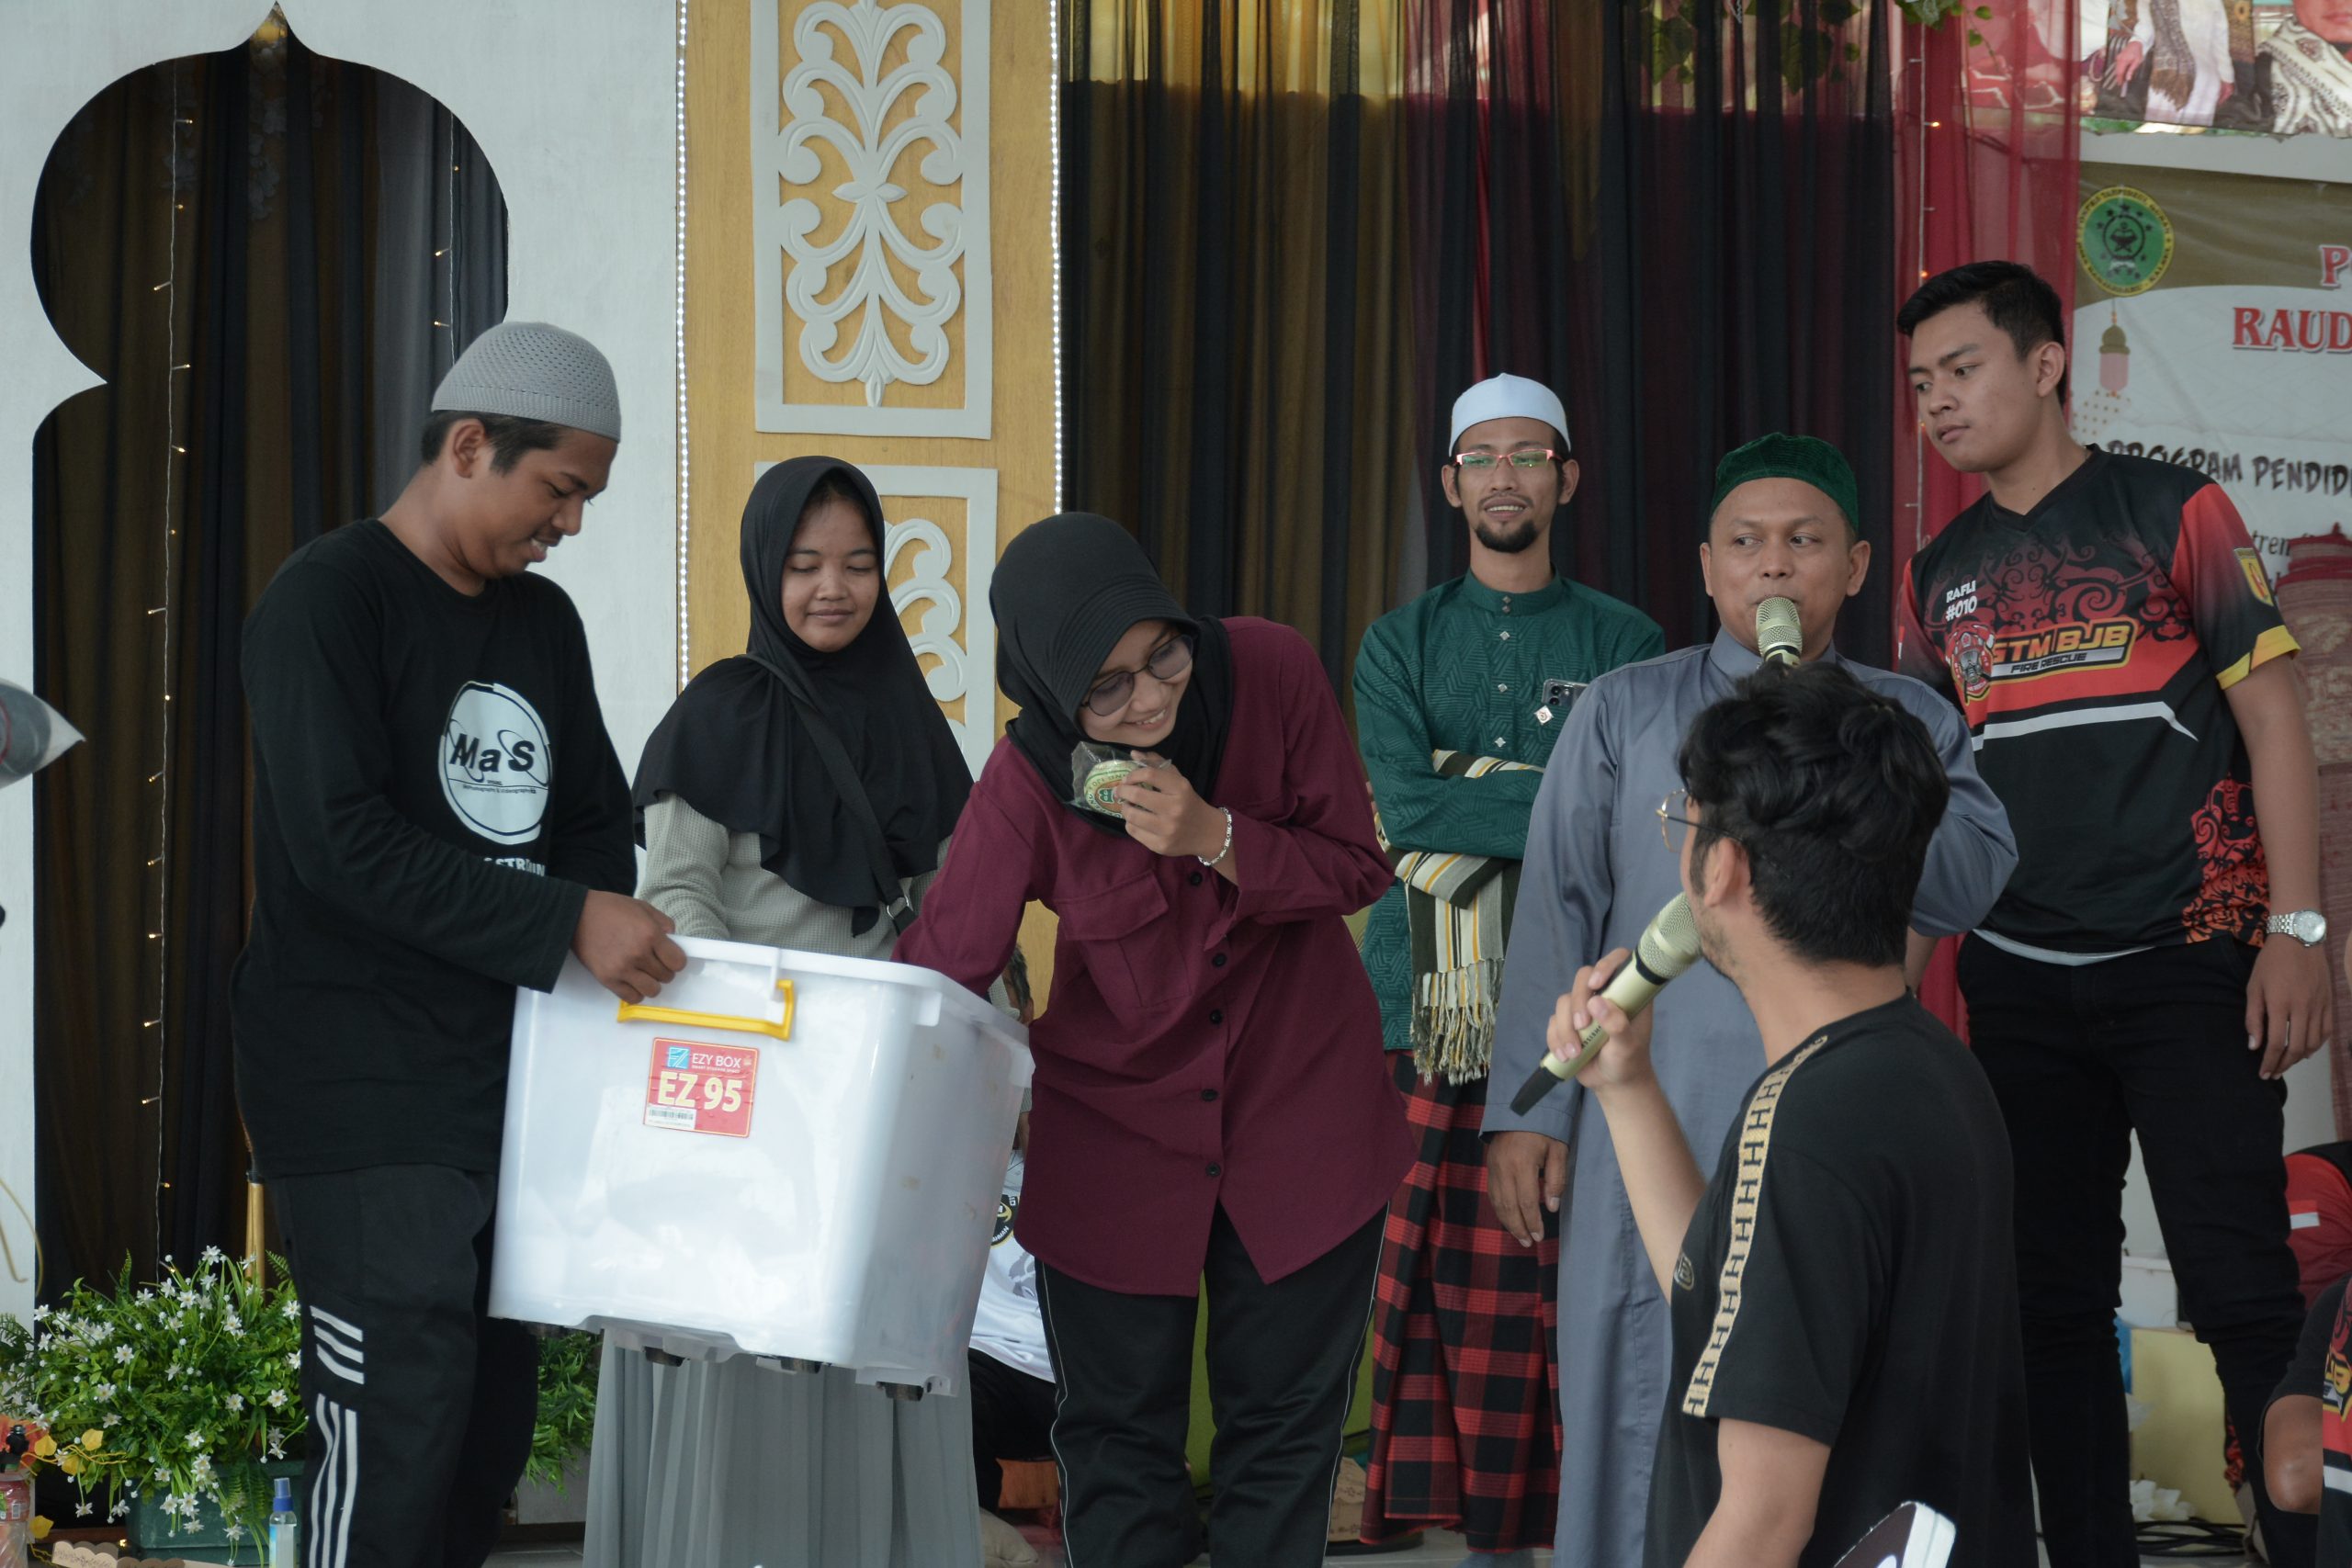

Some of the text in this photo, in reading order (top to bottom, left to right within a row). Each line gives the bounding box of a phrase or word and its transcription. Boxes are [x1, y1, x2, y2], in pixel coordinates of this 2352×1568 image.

[2319, 244, 2352, 288] P
[1946, 581, 1976, 604] RAFLI
[1945, 596, 1977, 622] #010
[1994, 625, 2131, 662] STM BJB
[2010, 652, 2087, 674] FIRE RESCUE
[449, 733, 536, 773] MaS
[692, 1054, 741, 1068] EZY BOX
[657, 1071, 743, 1112] EZ 95
